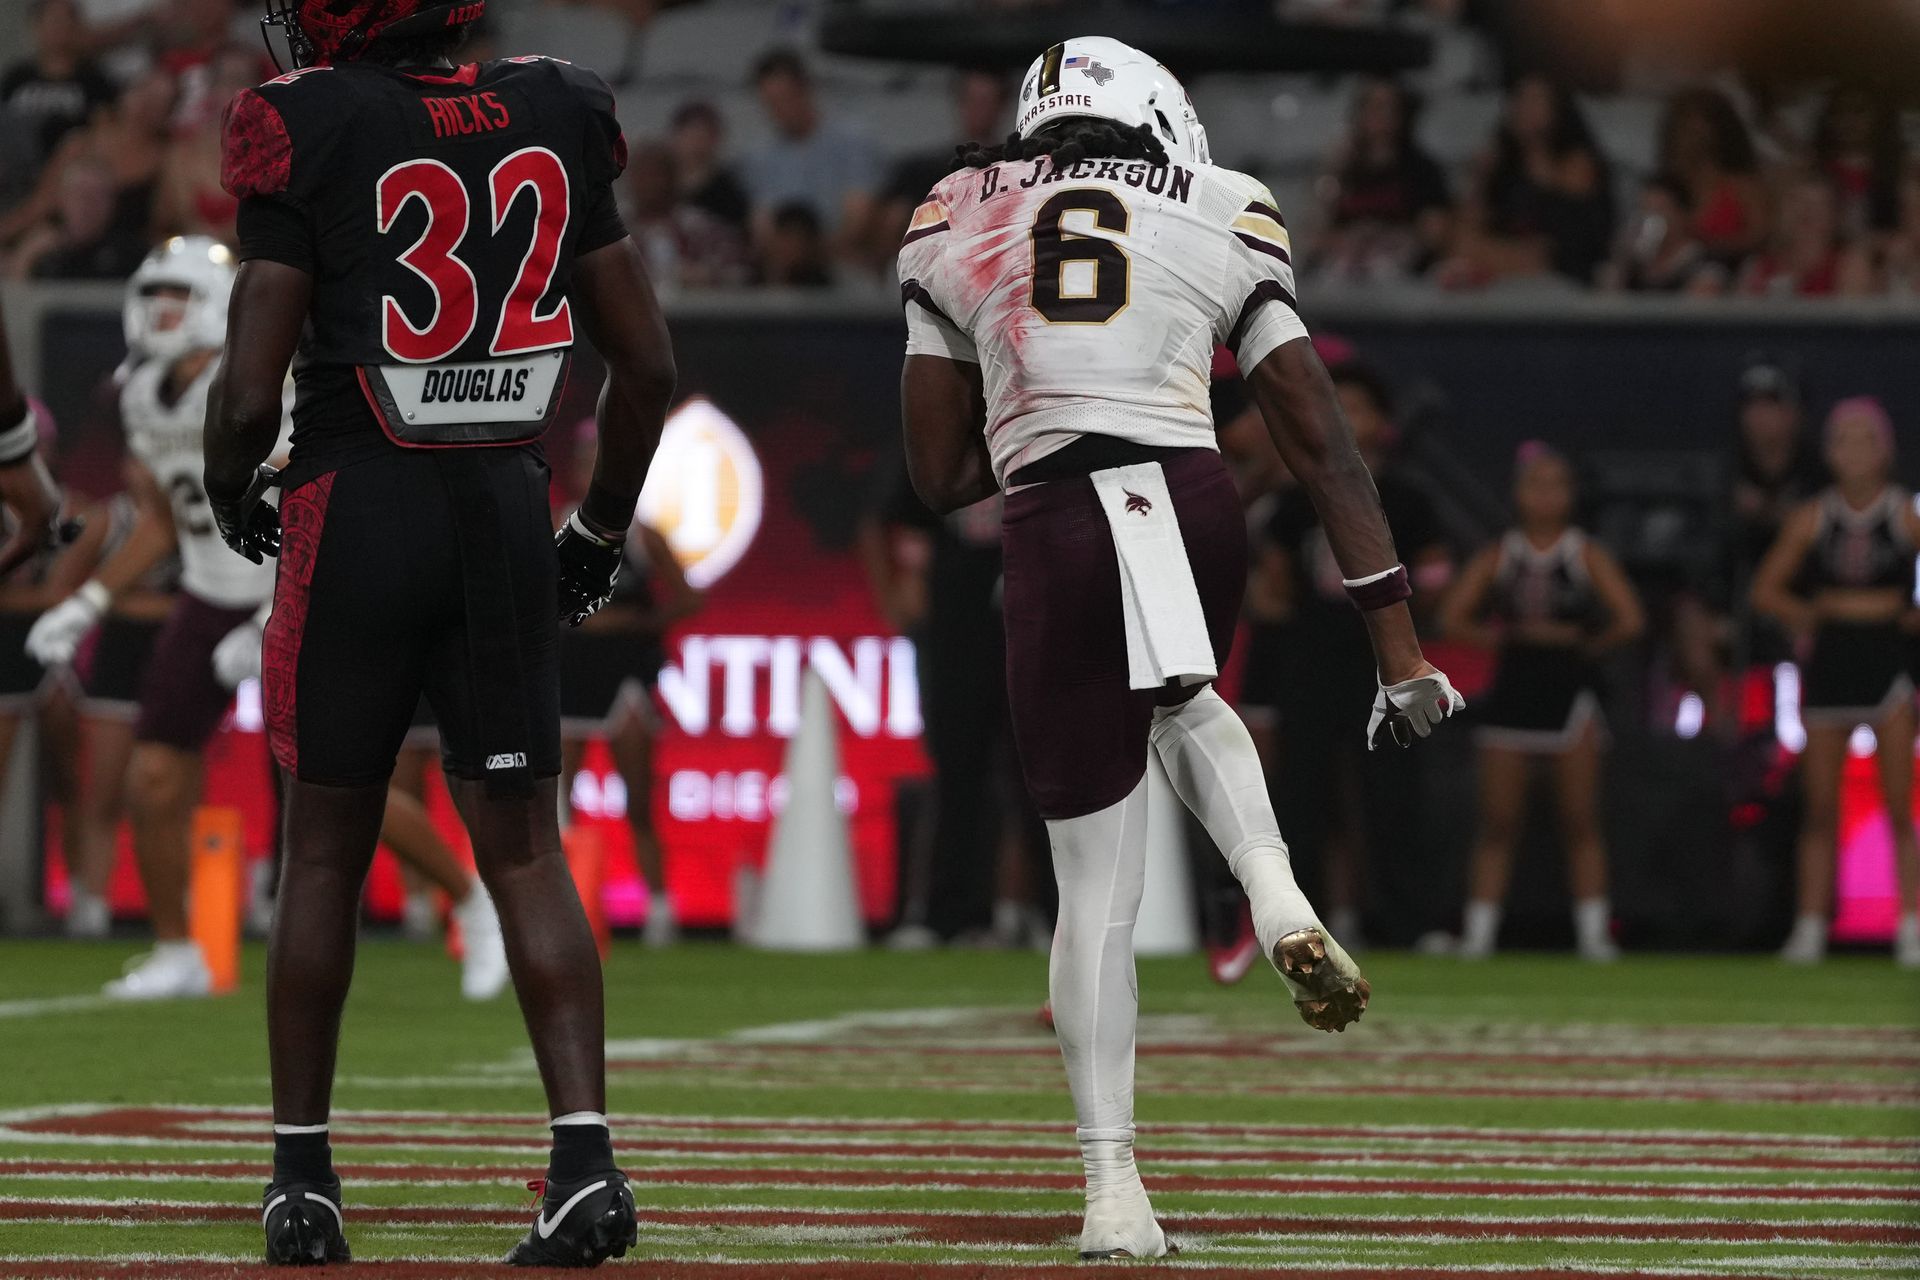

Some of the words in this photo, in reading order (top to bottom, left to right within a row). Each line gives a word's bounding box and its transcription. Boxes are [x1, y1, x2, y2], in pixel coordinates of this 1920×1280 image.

[421, 92, 510, 138] RICKS
[1049, 94, 1092, 108] STATE
[979, 167, 1009, 203] D.
[376, 146, 574, 364] 32
[1028, 186, 1132, 326] 6
[421, 368, 530, 404] DOUGLAS
